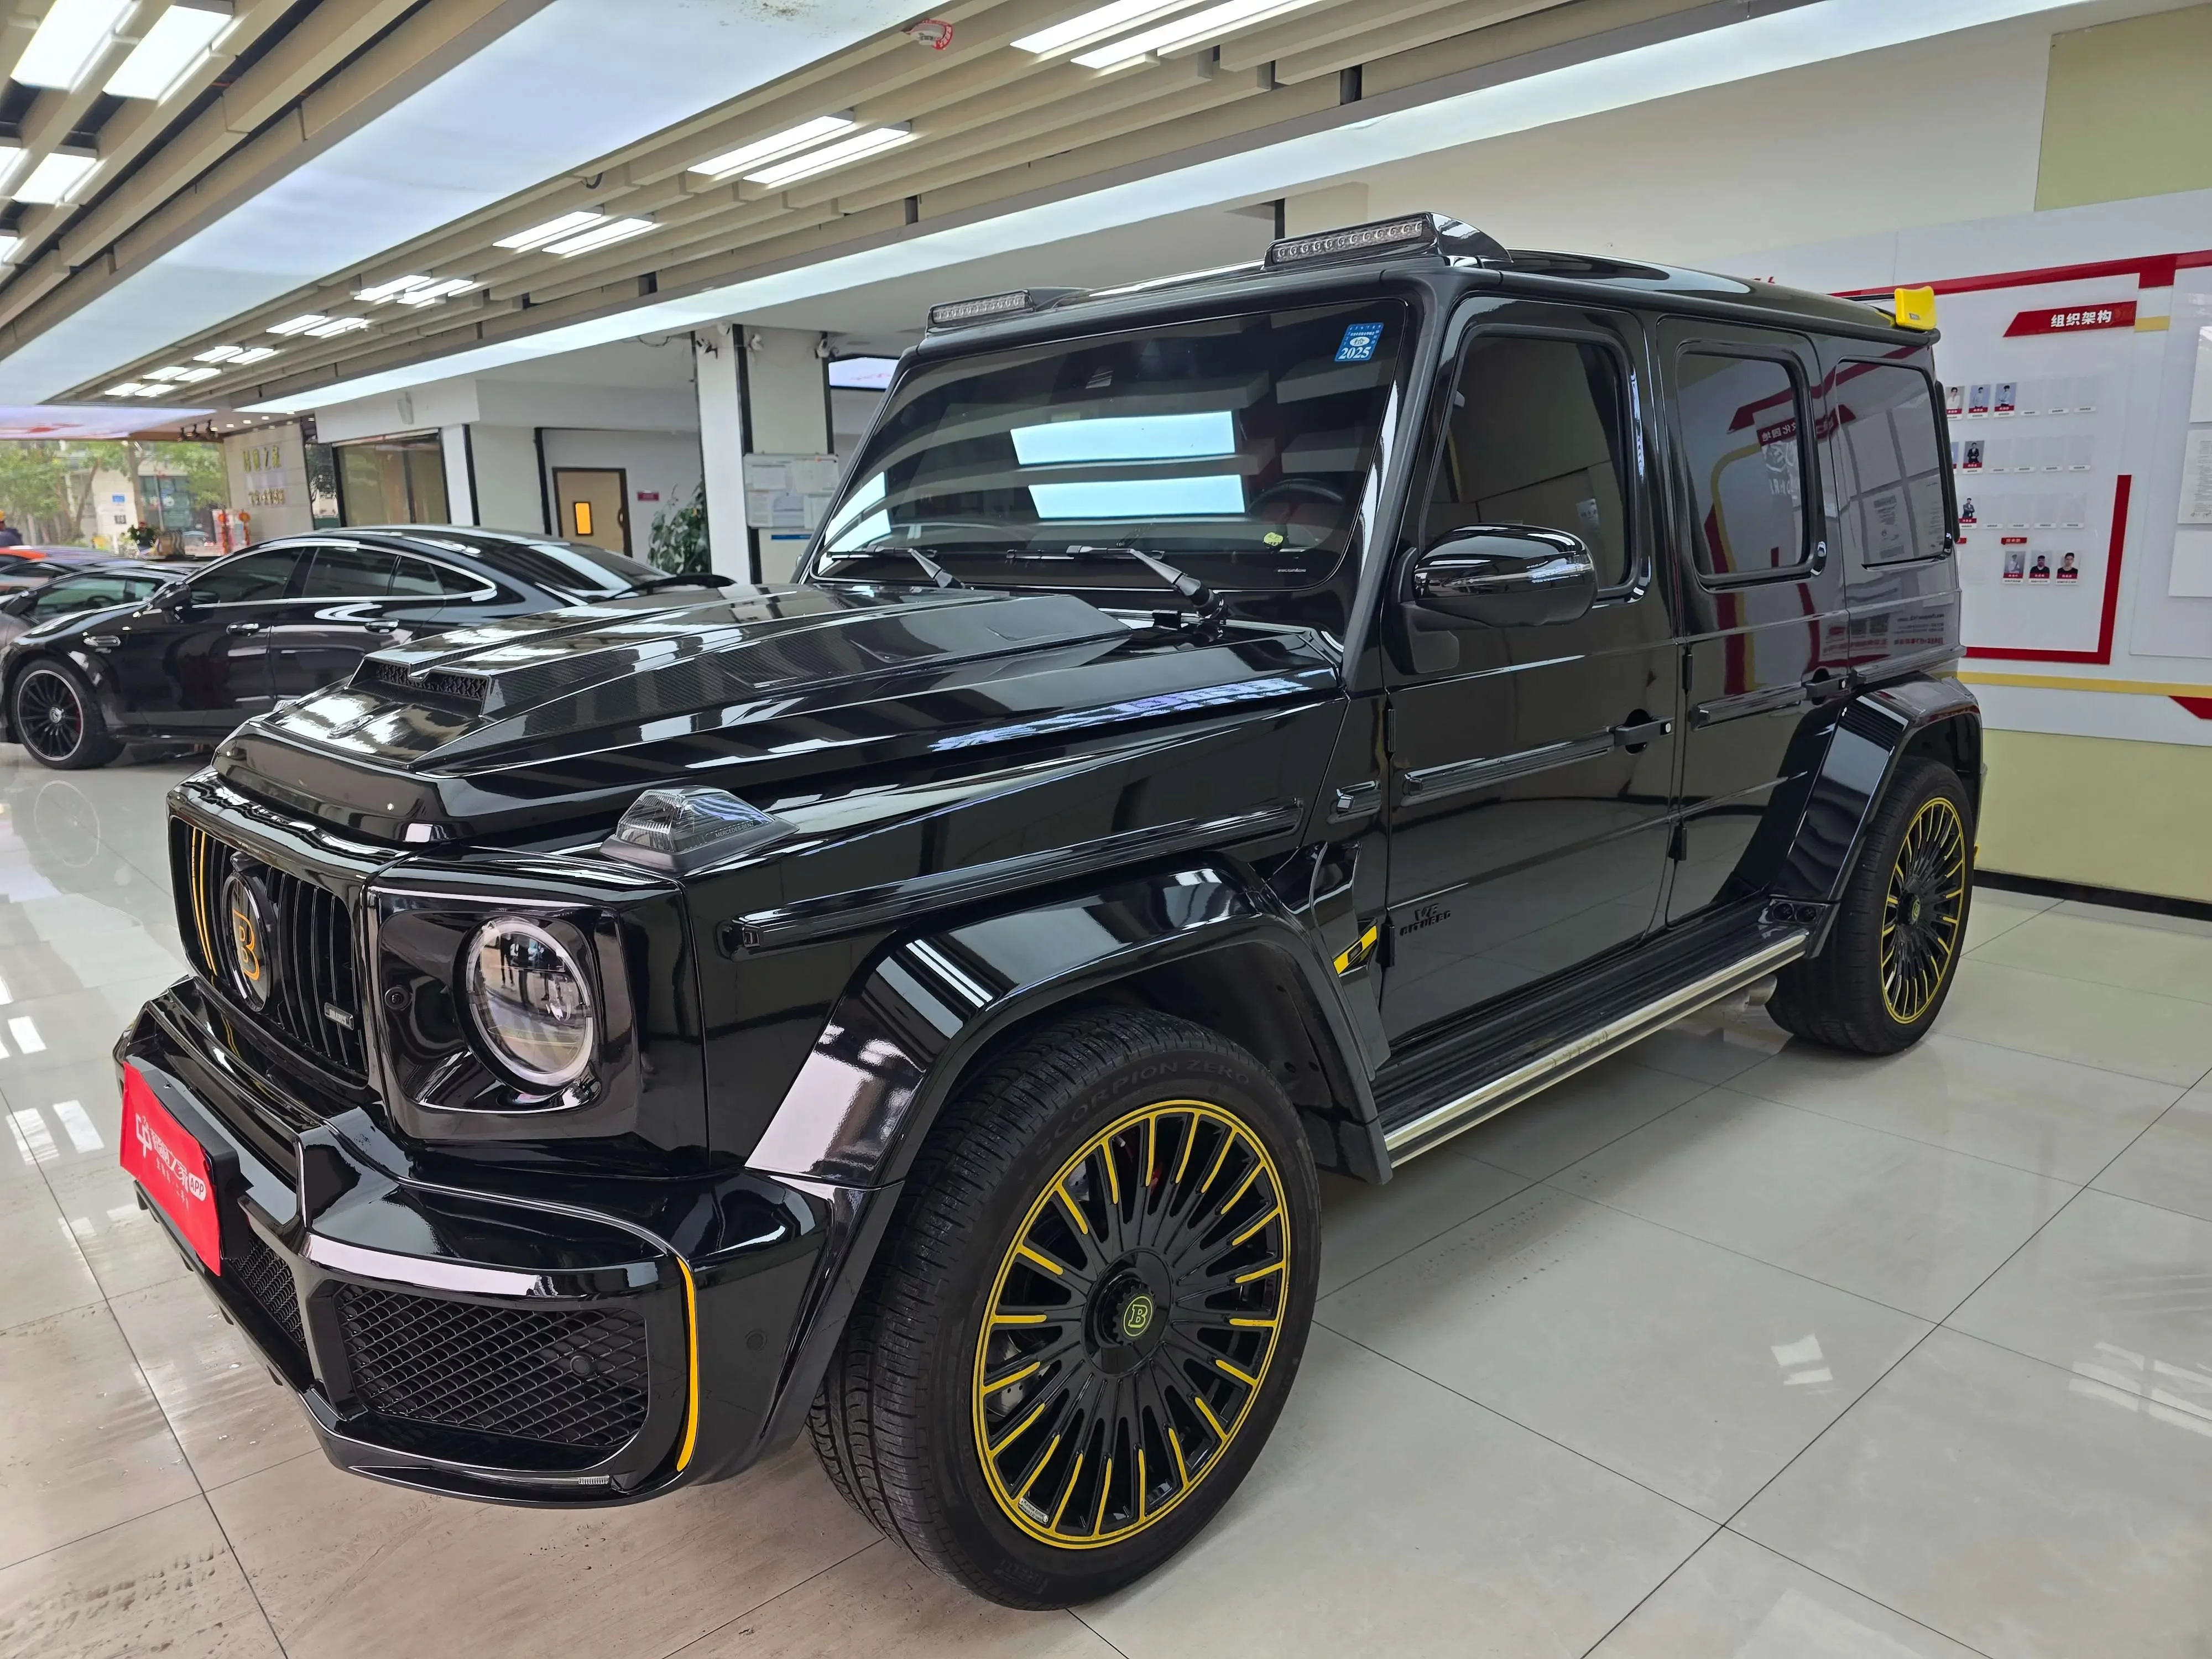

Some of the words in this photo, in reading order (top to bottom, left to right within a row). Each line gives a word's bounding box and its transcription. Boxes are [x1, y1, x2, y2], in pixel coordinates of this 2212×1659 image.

[2051, 310, 2112, 327] 组织架构
[1338, 347, 1371, 359] 2025
[714, 821, 754, 838] MERCEDES-BENZ
[1035, 1060, 1179, 1158] SCORPION
[1185, 1058, 1250, 1086] ZERO
[190, 1177, 205, 1196] APP
